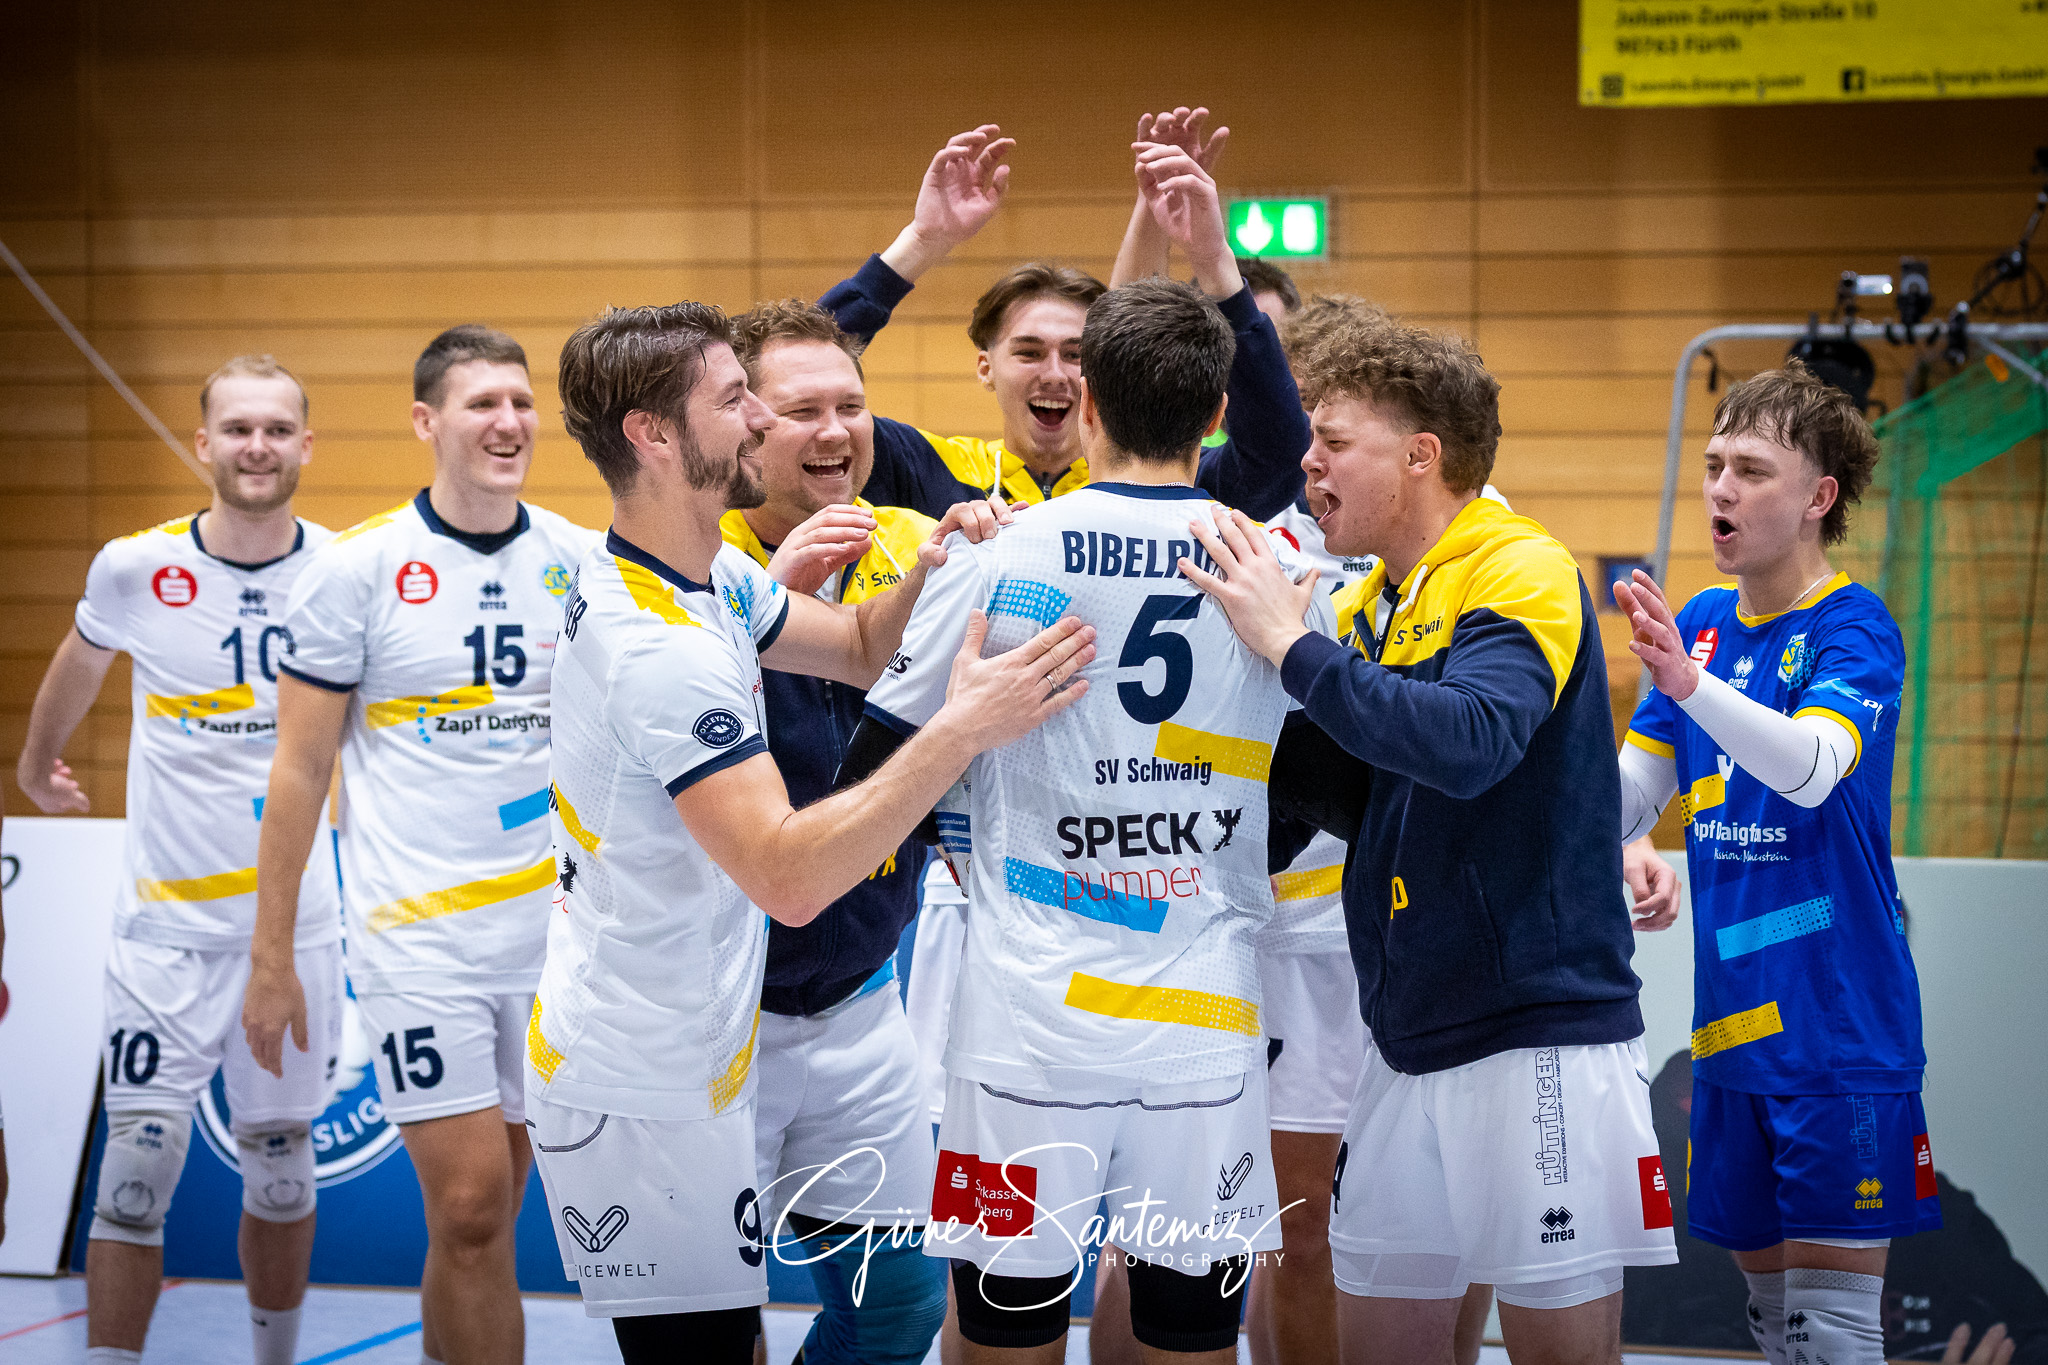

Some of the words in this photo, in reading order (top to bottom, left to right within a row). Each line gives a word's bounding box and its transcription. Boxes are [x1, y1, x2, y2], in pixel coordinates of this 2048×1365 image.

[1342, 561, 1373, 572] errea
[464, 624, 526, 688] 15
[1117, 594, 1202, 725] 5
[436, 714, 482, 735] Zapf
[1095, 758, 1120, 786] SV
[1127, 755, 1213, 787] Schwaig
[1056, 811, 1204, 860] SPECK
[110, 1027, 160, 1085] 10
[381, 1025, 445, 1094] 15
[733, 1187, 764, 1268] 9
[1854, 1198, 1884, 1210] errea
[1541, 1228, 1576, 1244] errea
